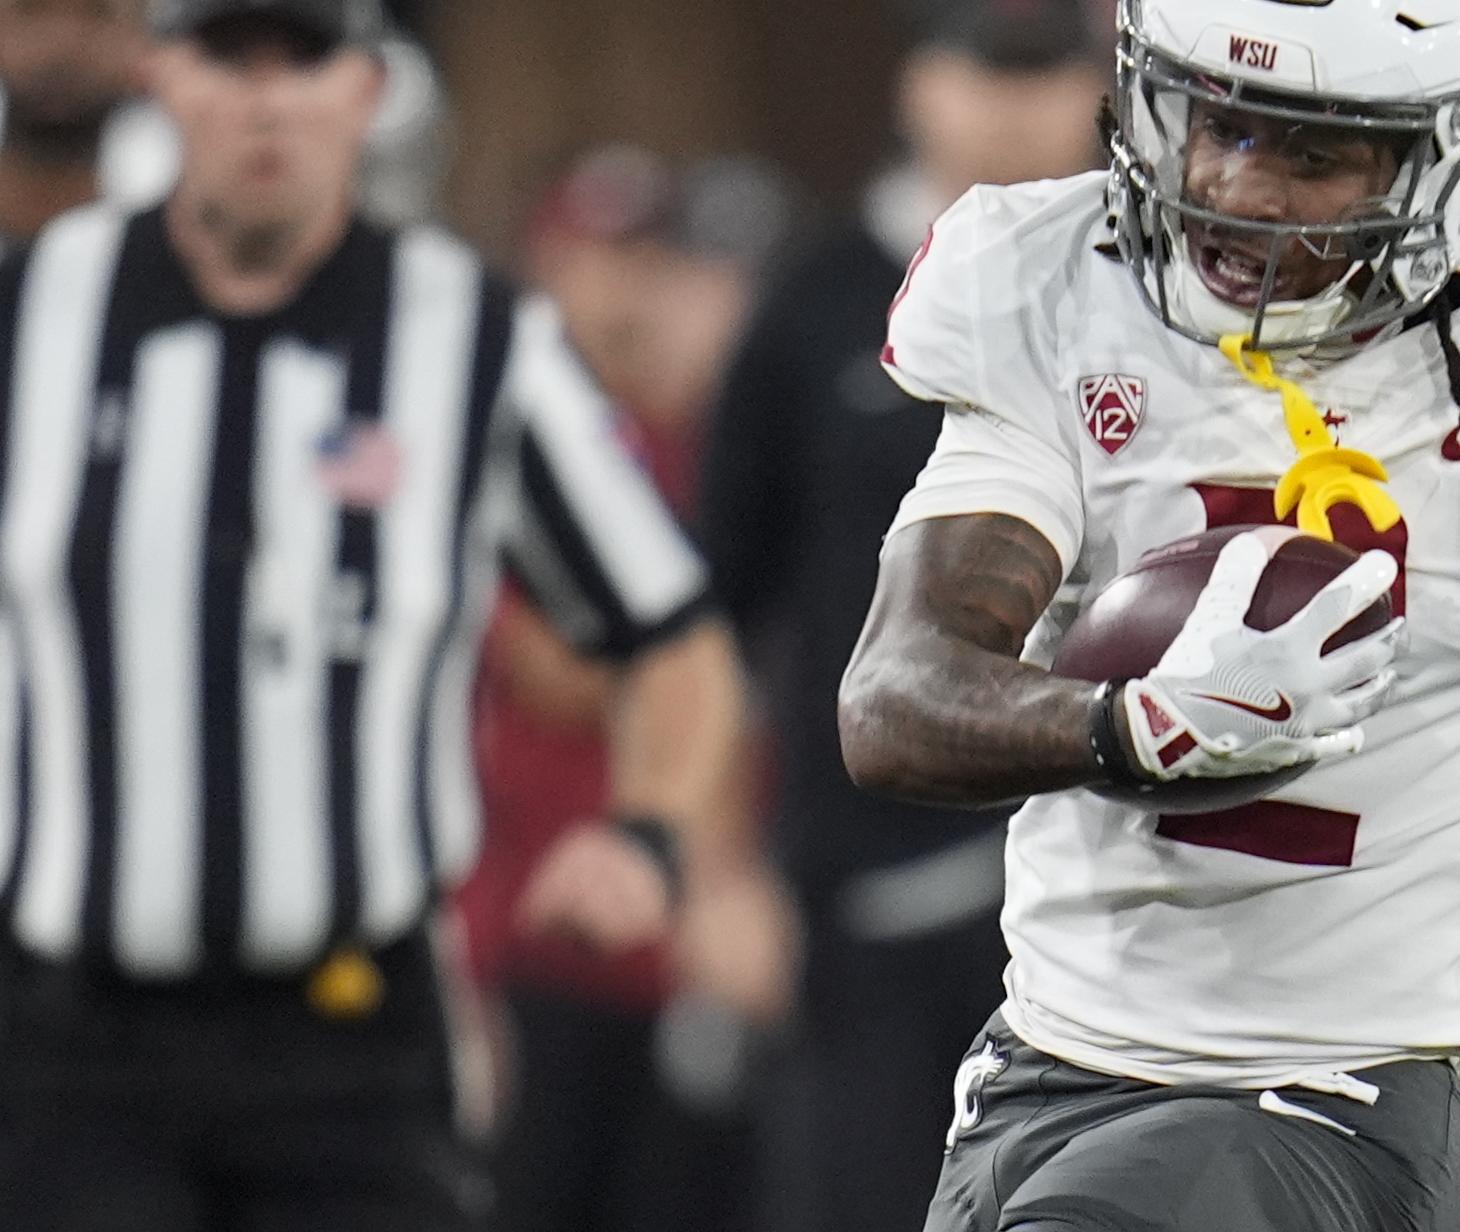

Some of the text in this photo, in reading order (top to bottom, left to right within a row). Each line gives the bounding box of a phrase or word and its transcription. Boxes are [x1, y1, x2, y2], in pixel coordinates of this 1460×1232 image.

[1229, 33, 1277, 71] WSU
[1080, 373, 1142, 424] PAC
[1095, 407, 1129, 441] 12
